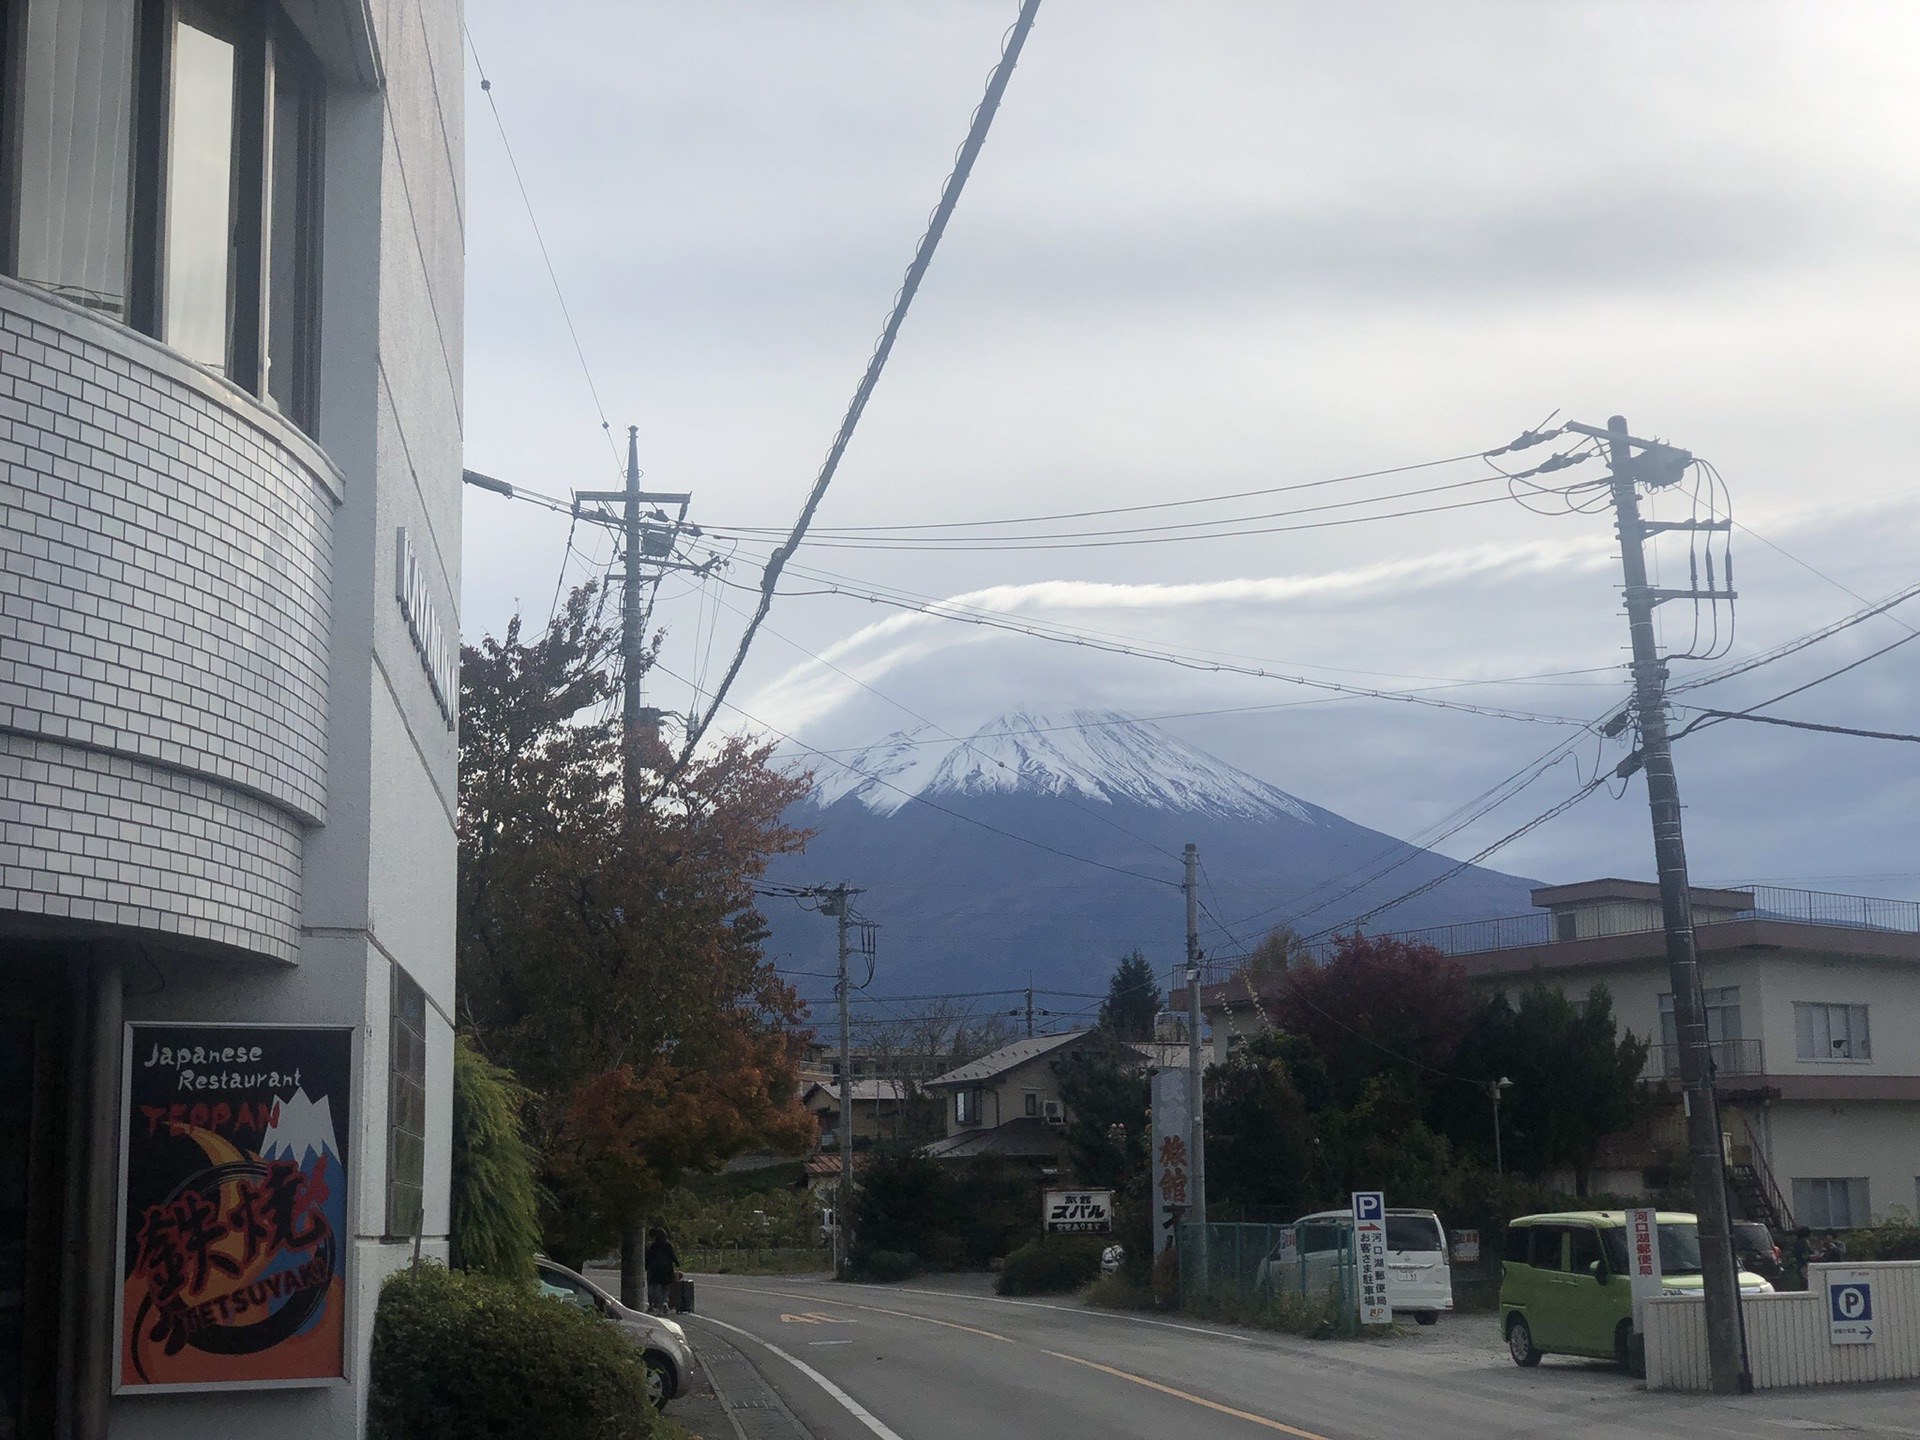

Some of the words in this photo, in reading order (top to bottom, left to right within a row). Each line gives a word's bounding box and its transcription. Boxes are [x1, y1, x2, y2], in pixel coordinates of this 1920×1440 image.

[144, 1043, 263, 1070] Japanese
[178, 1068, 302, 1092] Restaurant
[140, 1101, 281, 1136] TEPPAN
[1159, 1135, 1188, 1203] 旅館
[1051, 1205, 1106, 1220] スバル
[1065, 1195, 1092, 1205] 旅館
[1358, 1196, 1378, 1219] P
[1635, 1211, 1653, 1276] 河口湖郵便局
[1360, 1232, 1376, 1307] お客さま駐車場
[1372, 1232, 1387, 1306] 河口湖郵便局
[1845, 1292, 1859, 1314] P
